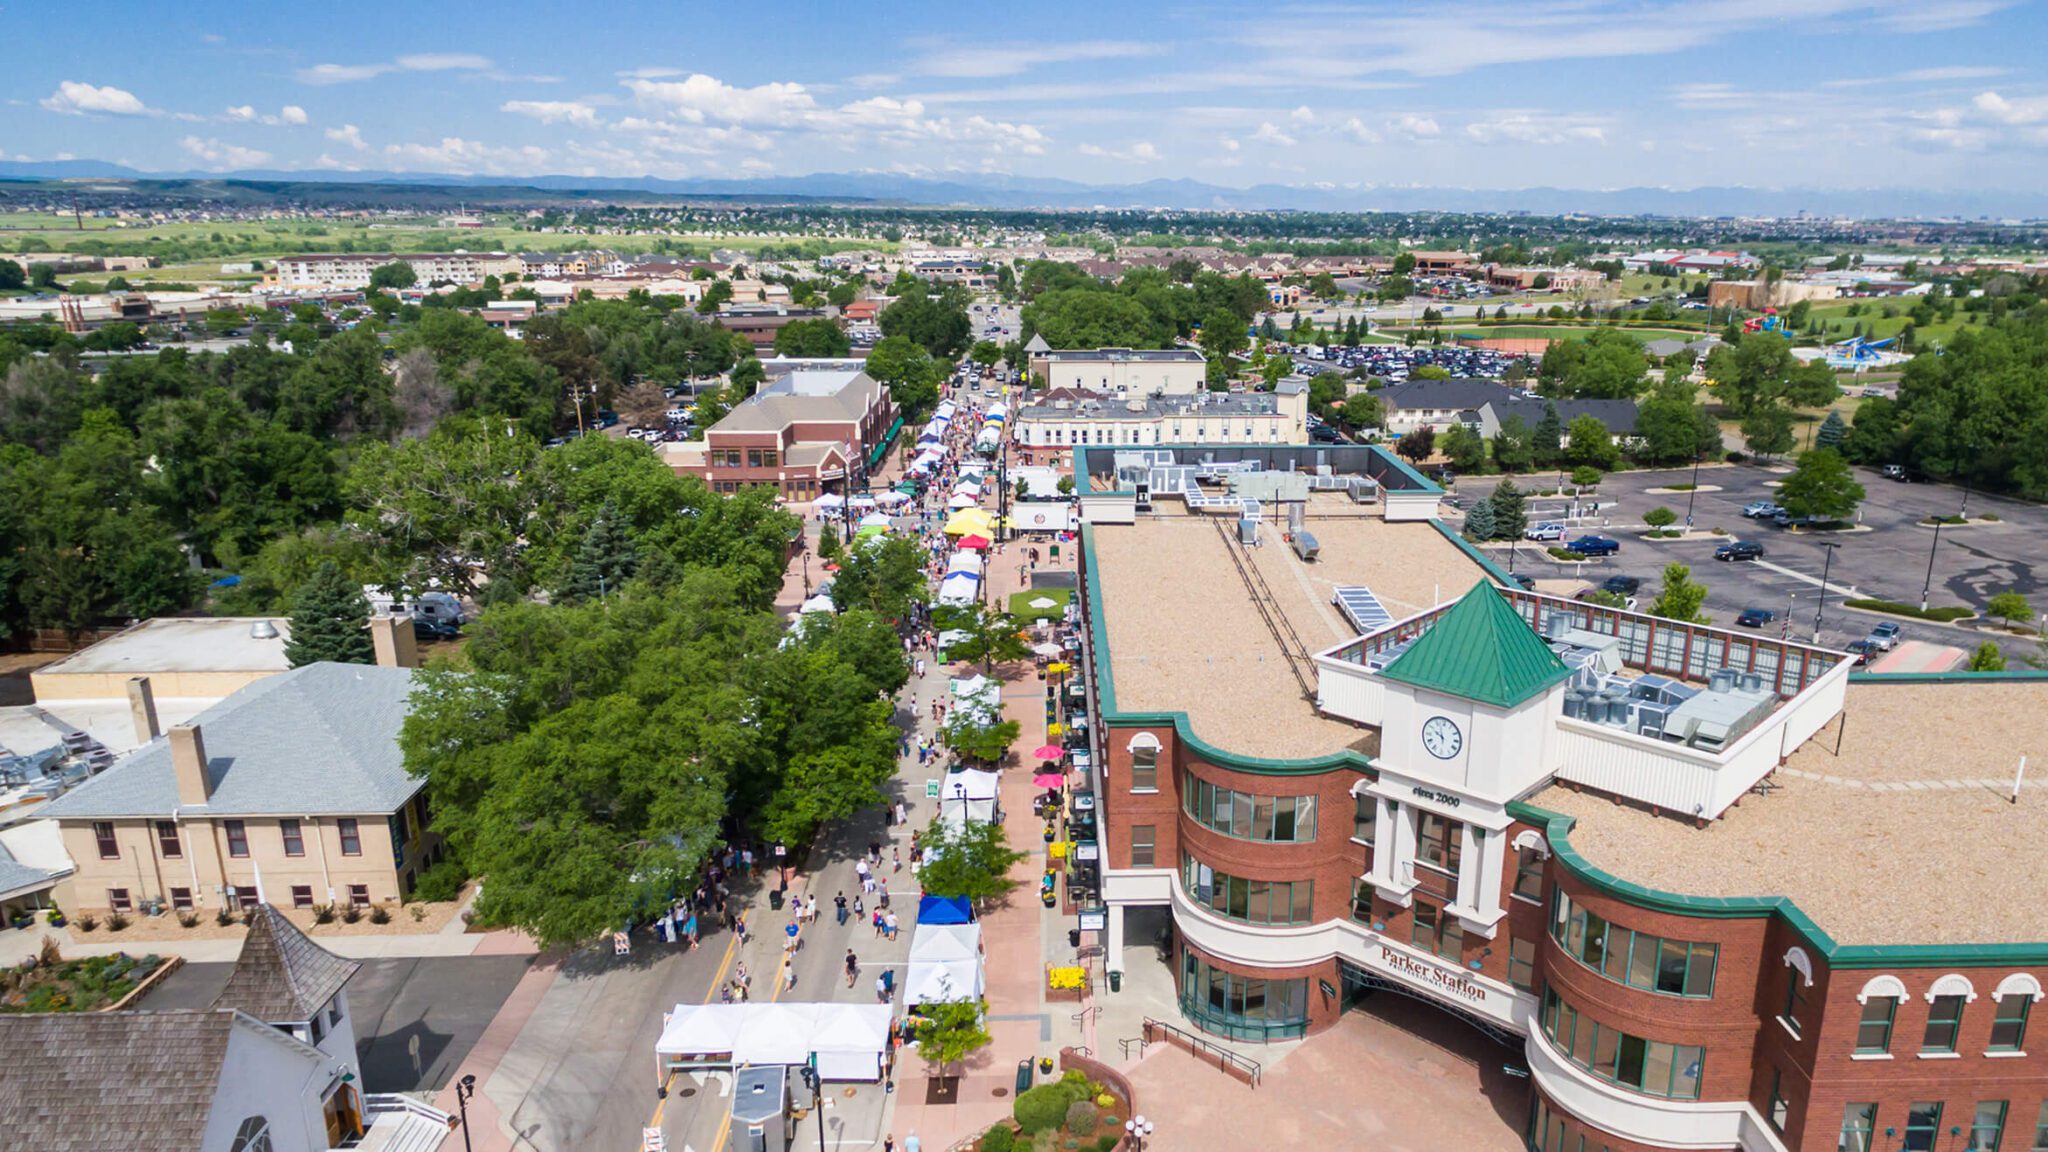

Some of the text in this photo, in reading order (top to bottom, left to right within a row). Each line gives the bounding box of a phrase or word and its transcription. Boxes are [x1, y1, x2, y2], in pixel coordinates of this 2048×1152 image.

[1436, 792, 1460, 807] 2000
[1382, 946, 1486, 1000] Parker Station
[1389, 963, 1477, 1001] PROFESSIONAL OFFICES
